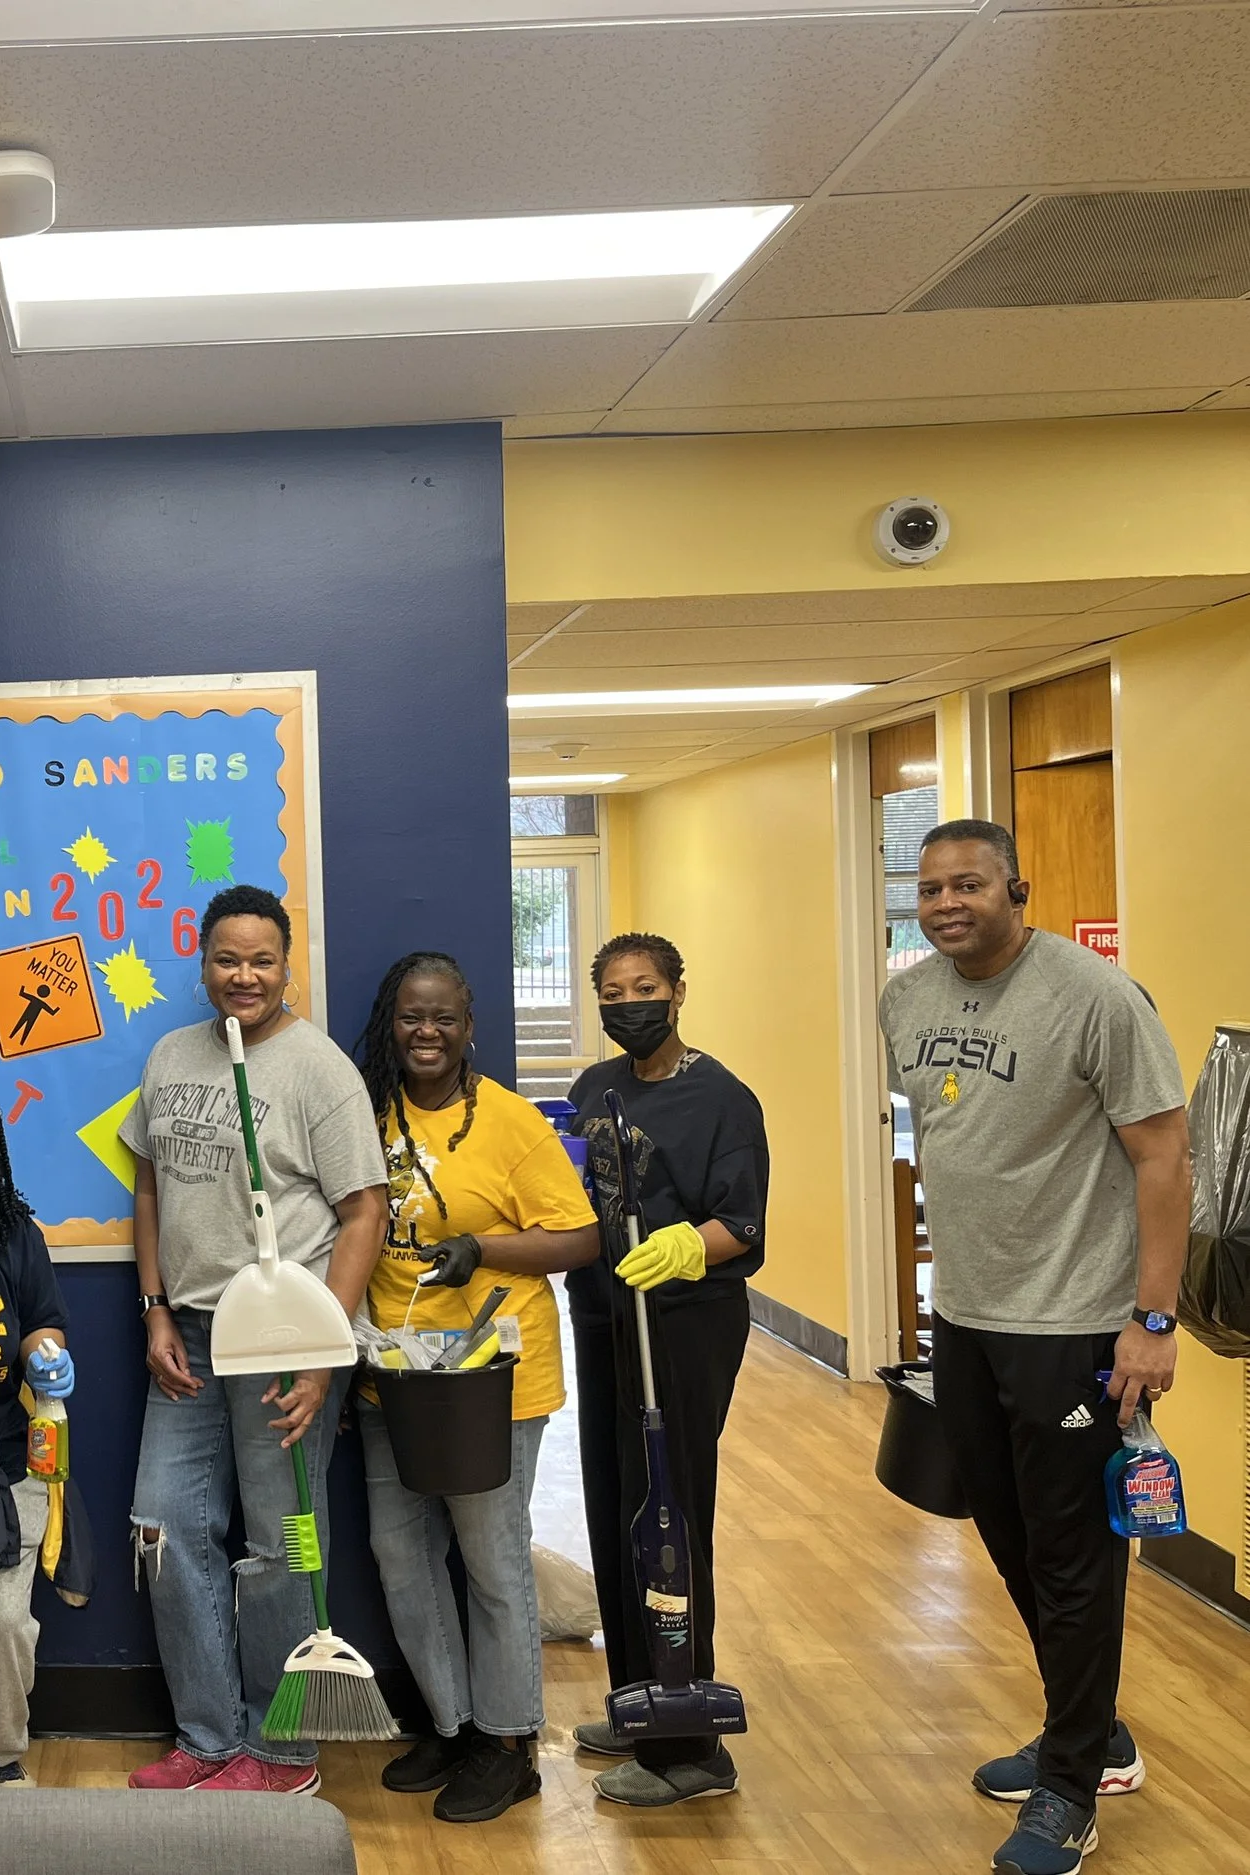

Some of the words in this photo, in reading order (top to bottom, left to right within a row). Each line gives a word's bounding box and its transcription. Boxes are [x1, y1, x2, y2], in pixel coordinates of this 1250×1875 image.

[44, 752, 249, 787] SANDERS
[49, 858, 199, 958] 2026
[26, 957, 79, 997] MATTER
[49, 947, 78, 973] YOU
[915, 1026, 967, 1040] GOLDEN
[972, 1027, 1008, 1045] BULLS
[901, 1037, 1017, 1083] JCSU
[173, 1123, 194, 1136] EST.
[149, 1135, 236, 1173] UNIVERSITY
[1061, 1418, 1095, 1428] adidas
